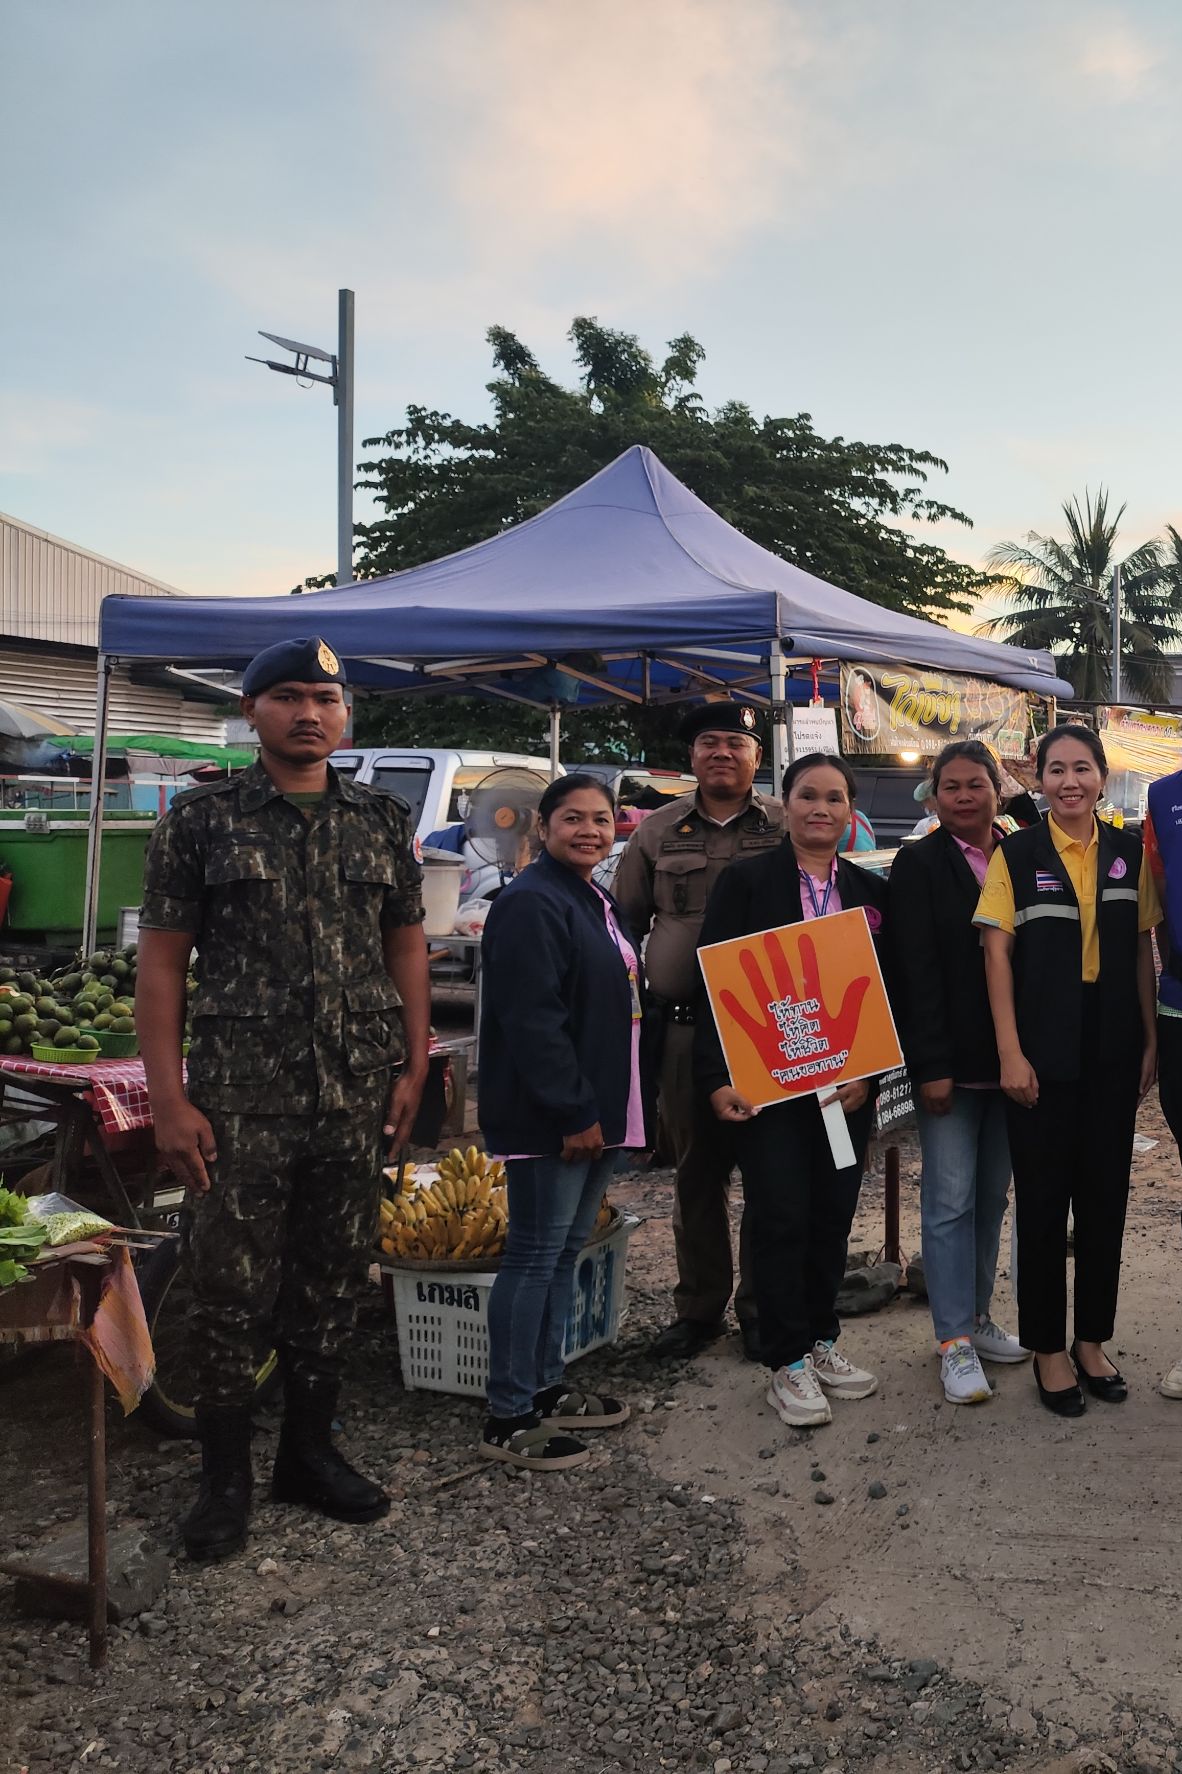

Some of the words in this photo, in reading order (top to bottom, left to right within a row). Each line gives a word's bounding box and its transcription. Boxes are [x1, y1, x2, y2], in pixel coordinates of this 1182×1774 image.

[768, 995, 820, 1021] ให้ทาน
[778, 1017, 821, 1040] ให้คิด
[778, 1036, 829, 1060] ให้ชีวิต
